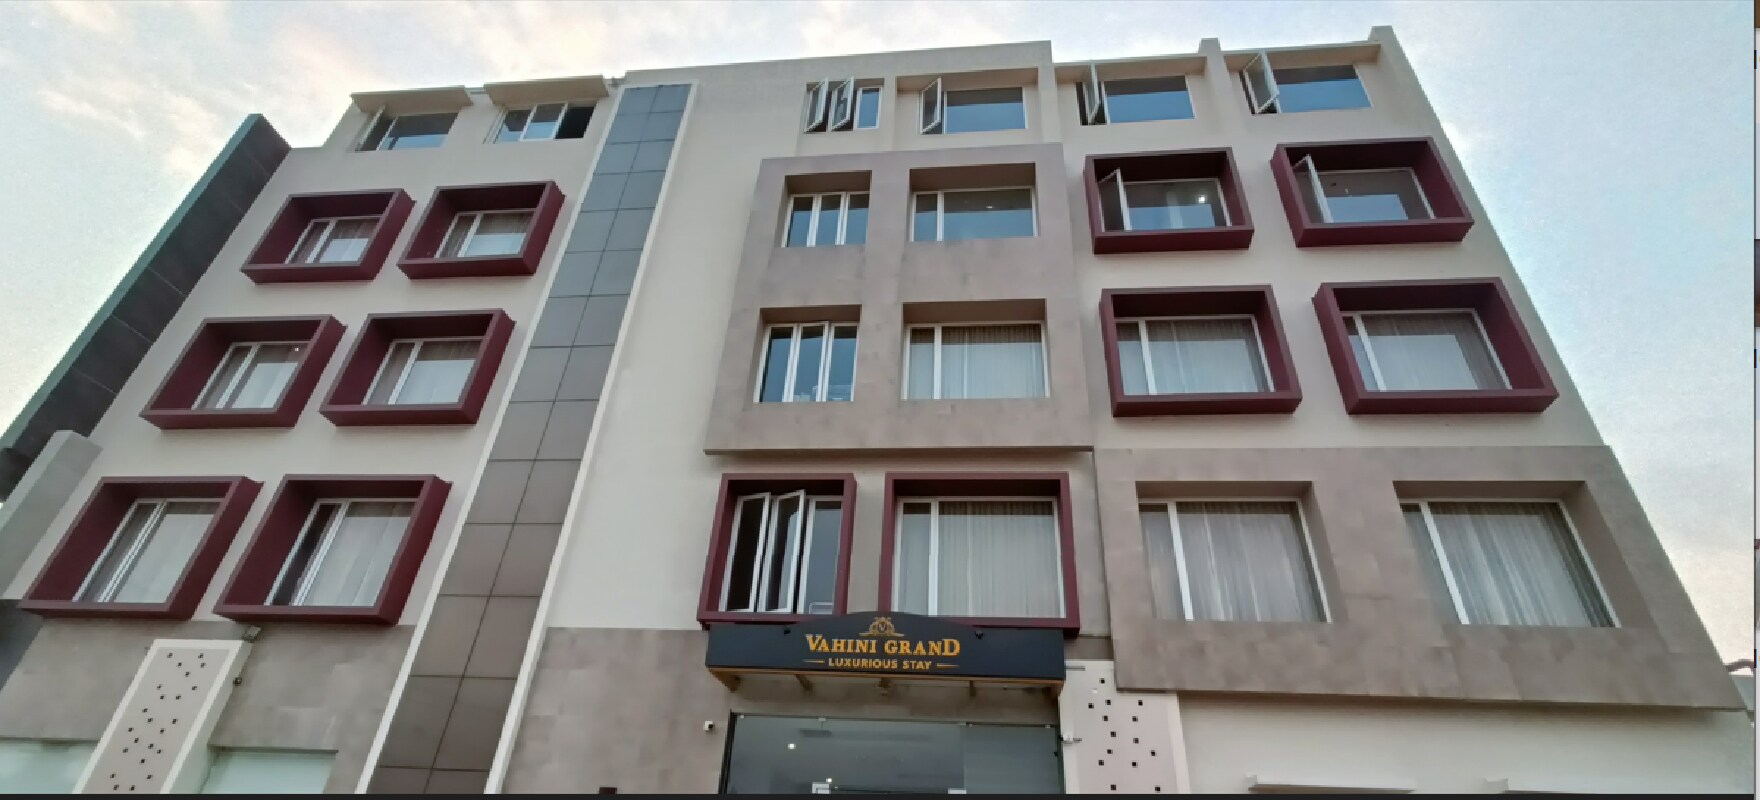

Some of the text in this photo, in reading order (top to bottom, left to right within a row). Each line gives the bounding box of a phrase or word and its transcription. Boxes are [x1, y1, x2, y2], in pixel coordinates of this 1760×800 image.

[805, 634, 961, 656] VAHINI GRAND
[828, 658, 932, 670] LUXURIOUS STAY
